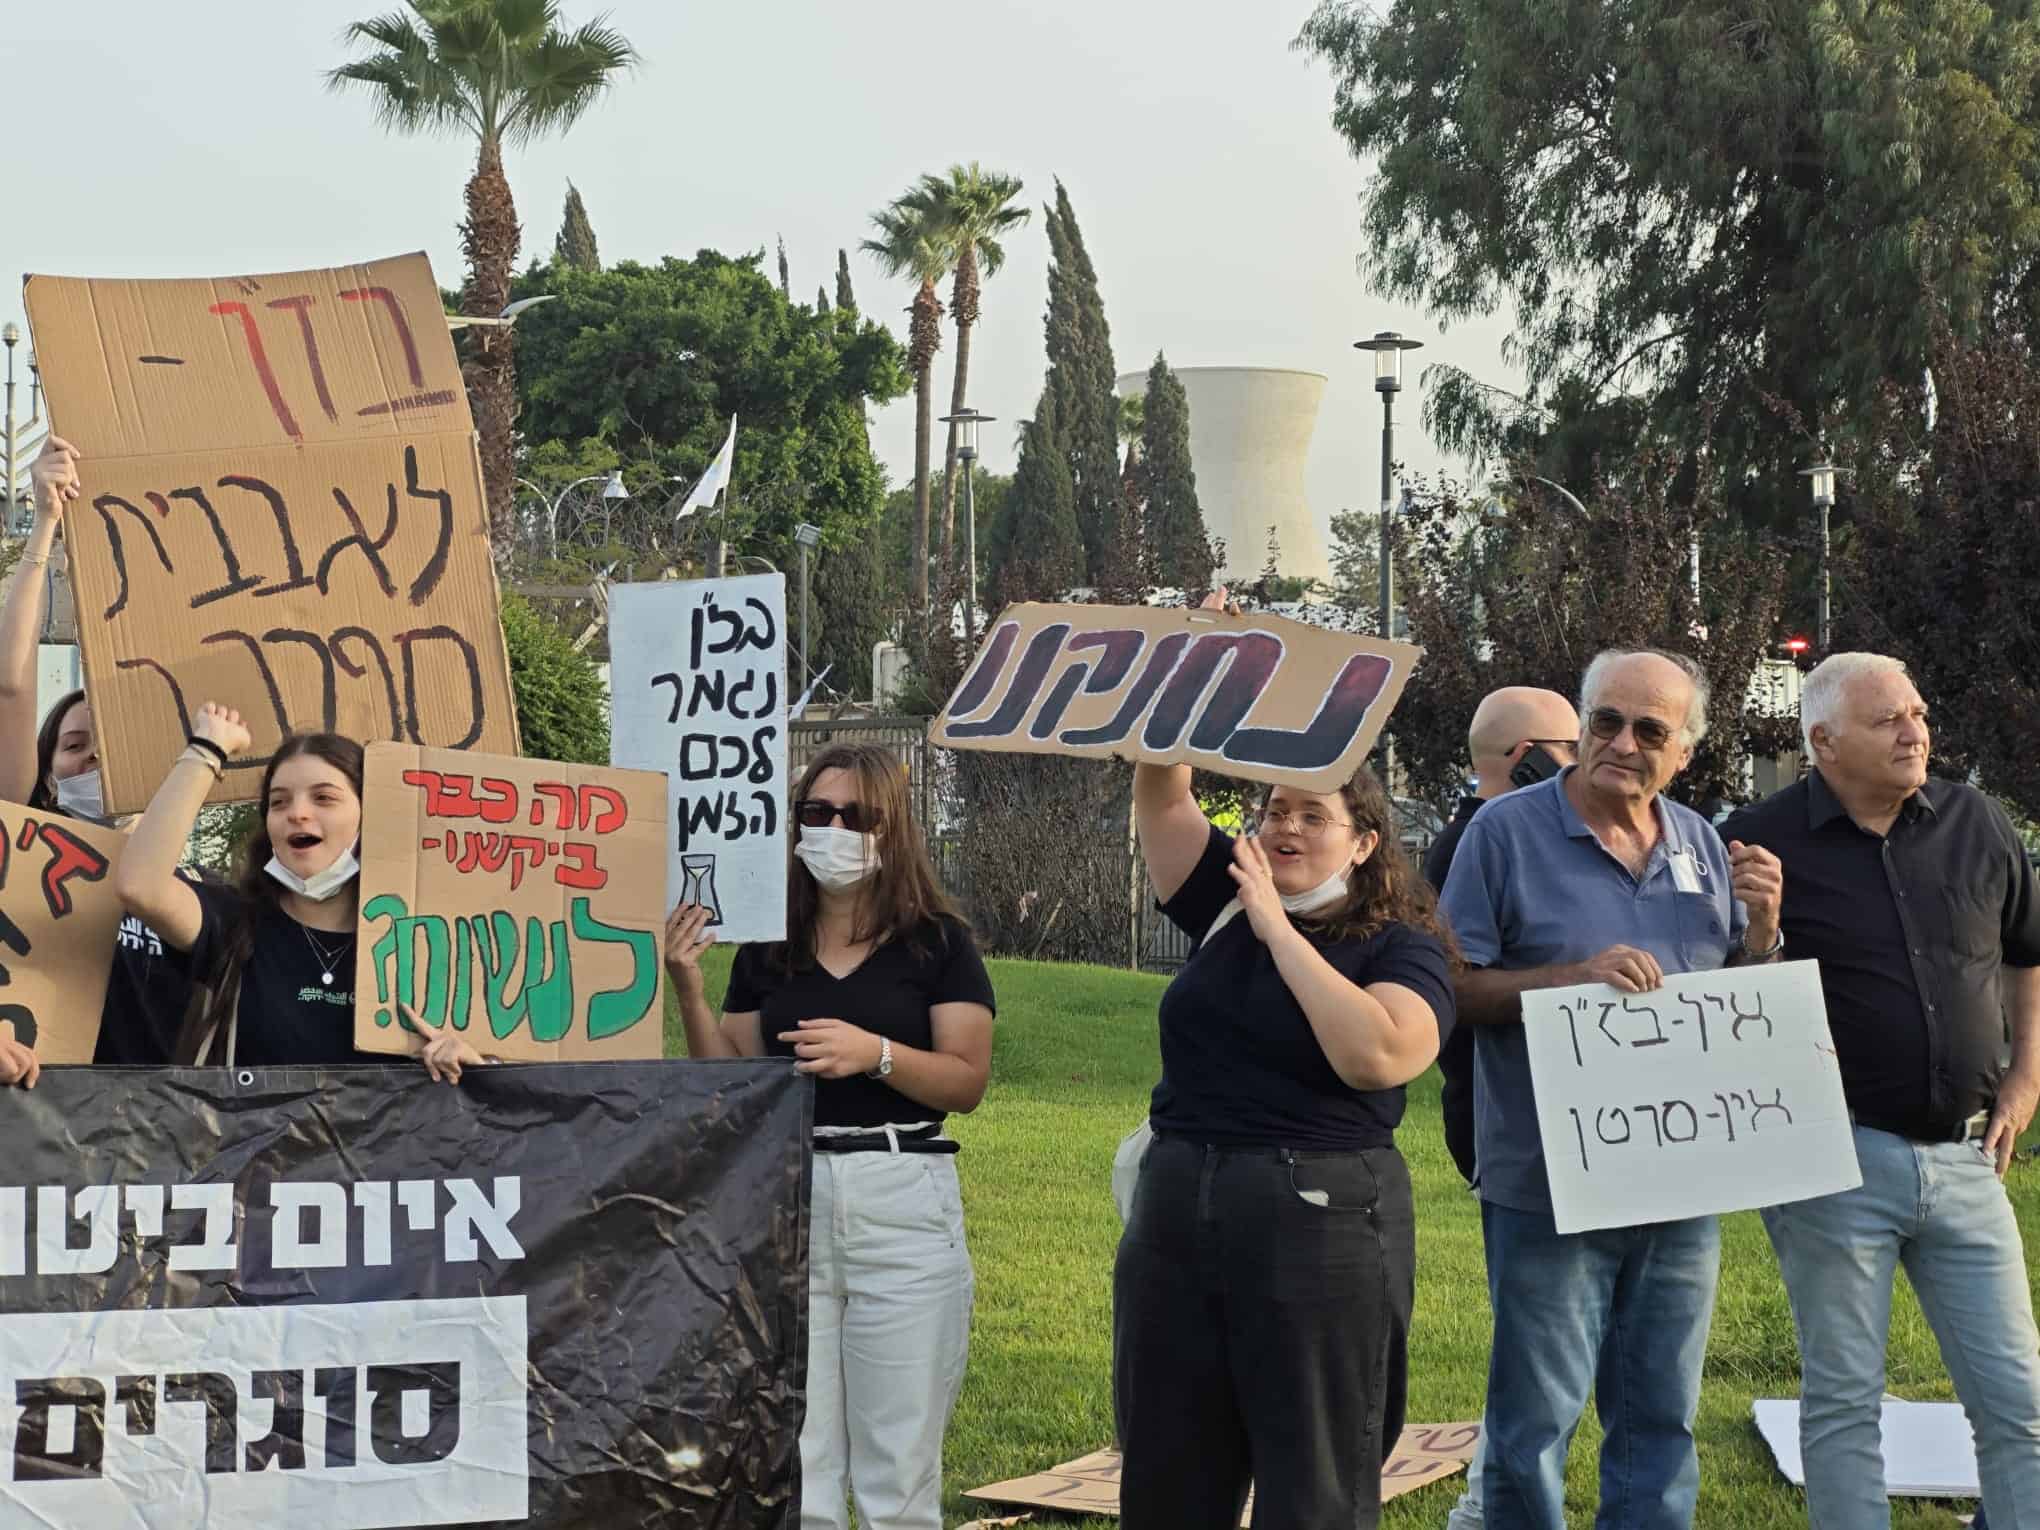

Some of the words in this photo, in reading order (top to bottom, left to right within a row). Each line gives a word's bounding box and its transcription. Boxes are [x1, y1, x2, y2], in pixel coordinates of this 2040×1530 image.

[690, 592, 776, 670] בז"ן
[651, 668, 776, 723] נגמר
[944, 621, 1394, 773] נחנקנו
[680, 726, 777, 784] לכם
[403, 770, 519, 823] כבר
[530, 779, 628, 834] מה
[678, 790, 776, 852] הזמן
[362, 894, 658, 1042] לנשום?
[270, 1175, 526, 1270] איום
[13, 1361, 461, 1482] סוגרים
